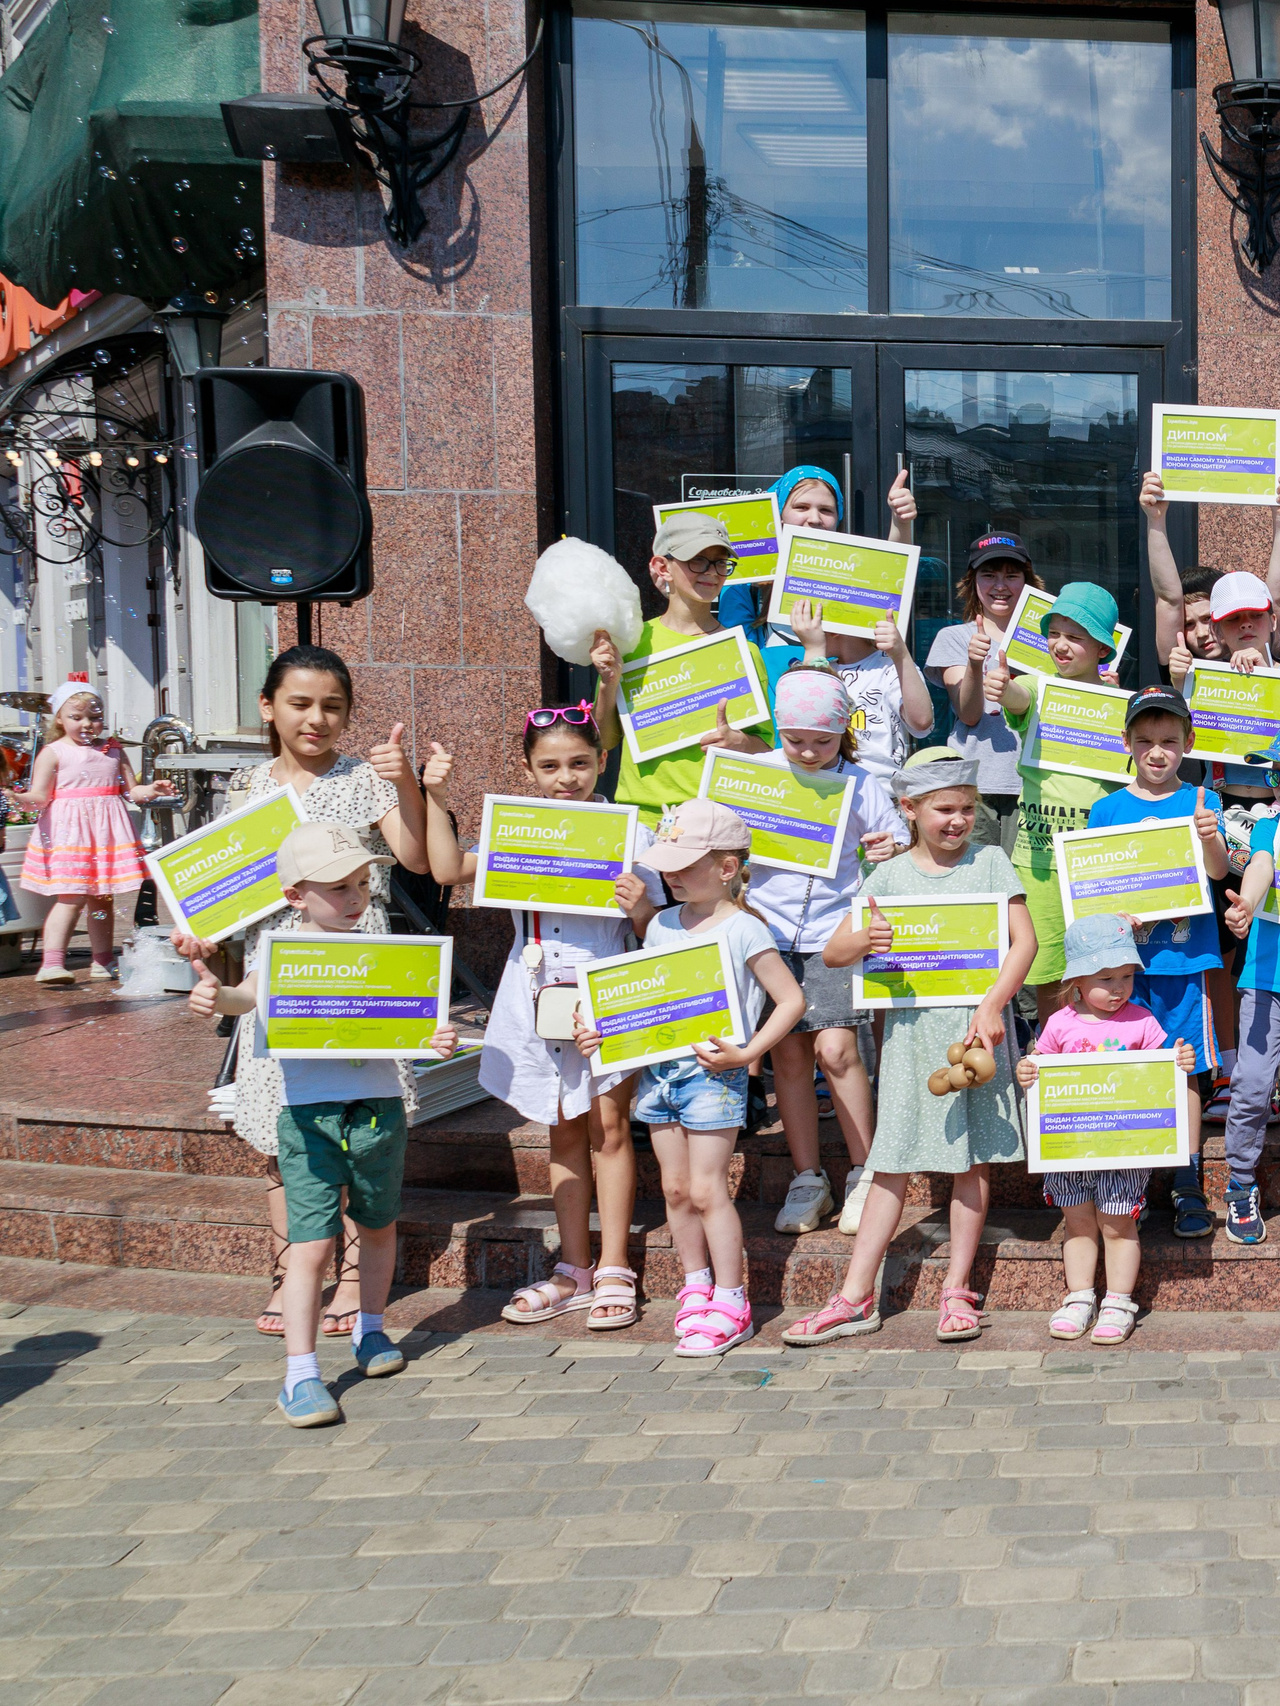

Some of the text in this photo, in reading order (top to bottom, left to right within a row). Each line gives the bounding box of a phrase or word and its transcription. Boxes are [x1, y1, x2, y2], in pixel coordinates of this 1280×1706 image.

[1167, 430, 1227, 442] ДИПЛОМ
[688, 487, 750, 500] Сормовские
[979, 537, 1016, 549] PRINCESS
[792, 553, 855, 572] ДИПЛОМ
[787, 585, 850, 600] ЮНОМУ КОНДИТЕРУ
[788, 579, 890, 601] ВЫДАН САМОМУ ТАЛАНТЛИВОМУ
[629, 670, 691, 701] ДИПЛОМ
[1196, 686, 1259, 702] ДИПЛОМ
[635, 683, 736, 721] ВЫДАН САМОМУ ТАЛАНТЛИВОМУ
[1046, 701, 1108, 720] ДИПЛОМ
[637, 702, 699, 727] ЮНОМУ КОНДИТЕРУ
[496, 824, 568, 840] ДИПЛОМ
[174, 841, 242, 886] ДИПЛОМ
[552, 860, 609, 870] ТАЛАНТЛИВОМУ
[1071, 849, 1138, 869] ДИПЛОМ
[522, 865, 564, 873] КОНДИТЕРУ
[1074, 871, 1184, 890] ВЫДАН САМОМУ ТАЛАНТЛИВОМУ
[1075, 883, 1143, 896] ЮНОМУ КОНДИТЕРУ
[278, 964, 368, 979] ДИПЛОМ
[597, 975, 665, 1003] ДИПЛОМ
[601, 996, 713, 1028] ВЫДАН САМОМУ ТАЛАНТЛИВОМУ
[602, 1013, 671, 1035] ЮНОМУ КОНДИТЕРУ
[1044, 1082, 1116, 1099] ДИПЛОМ
